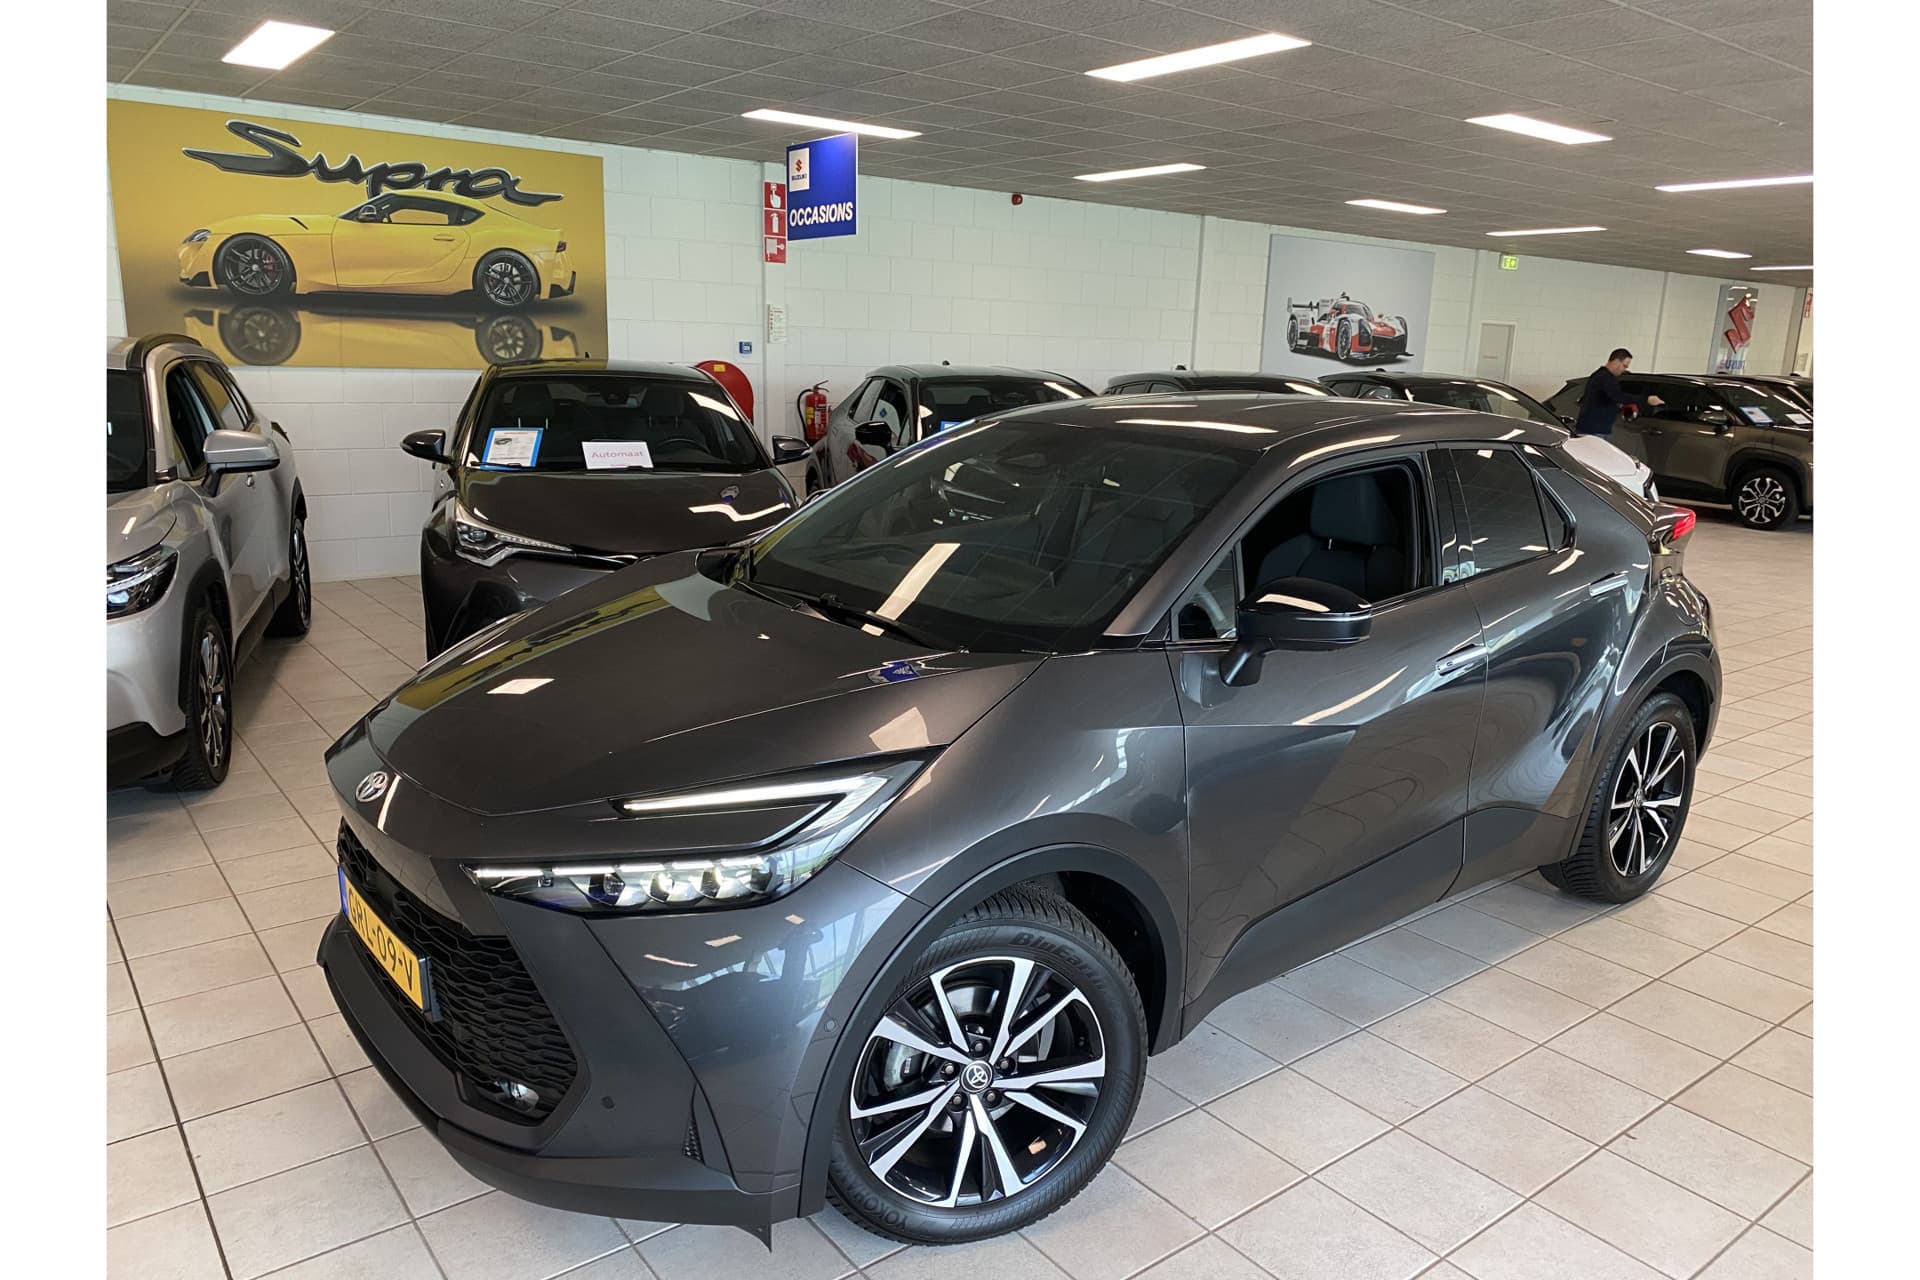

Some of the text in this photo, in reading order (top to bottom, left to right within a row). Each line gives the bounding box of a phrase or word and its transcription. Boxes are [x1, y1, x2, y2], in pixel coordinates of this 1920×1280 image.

[182, 119, 563, 207] Supra
[789, 201, 854, 227] OCCASIONS
[591, 451, 645, 459] Automaat
[348, 887, 413, 992] GRL-09-V
